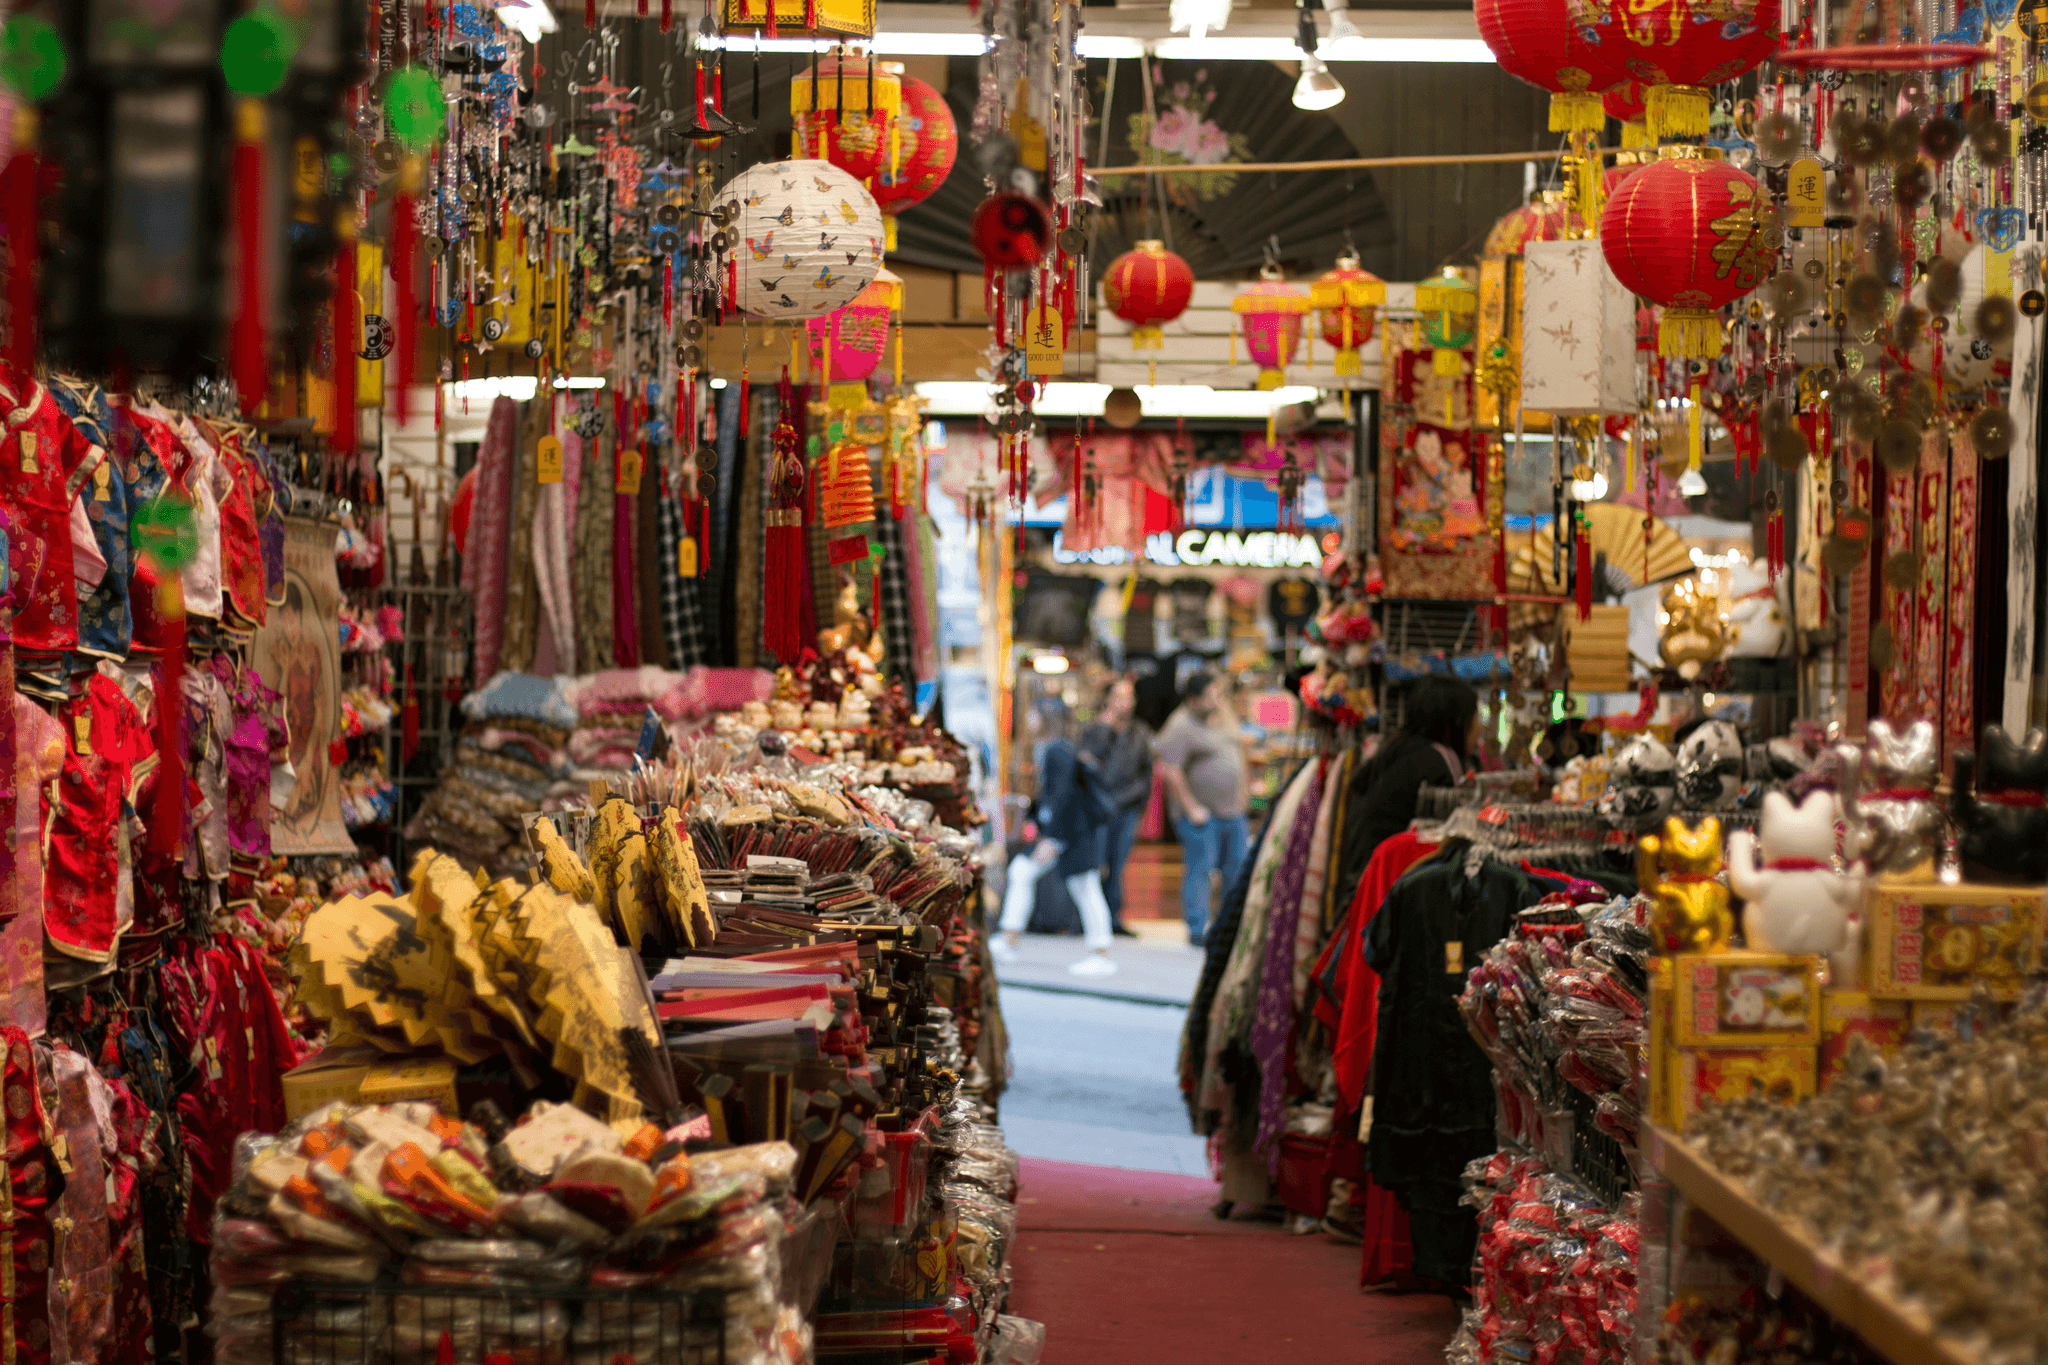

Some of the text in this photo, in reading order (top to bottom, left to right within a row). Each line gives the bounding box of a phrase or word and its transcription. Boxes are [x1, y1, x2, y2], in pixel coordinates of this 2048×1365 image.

[1796, 175, 1818, 201] 運
[1028, 353, 1061, 362] GOOD LUCK
[1176, 529, 1323, 568] CAMERA
